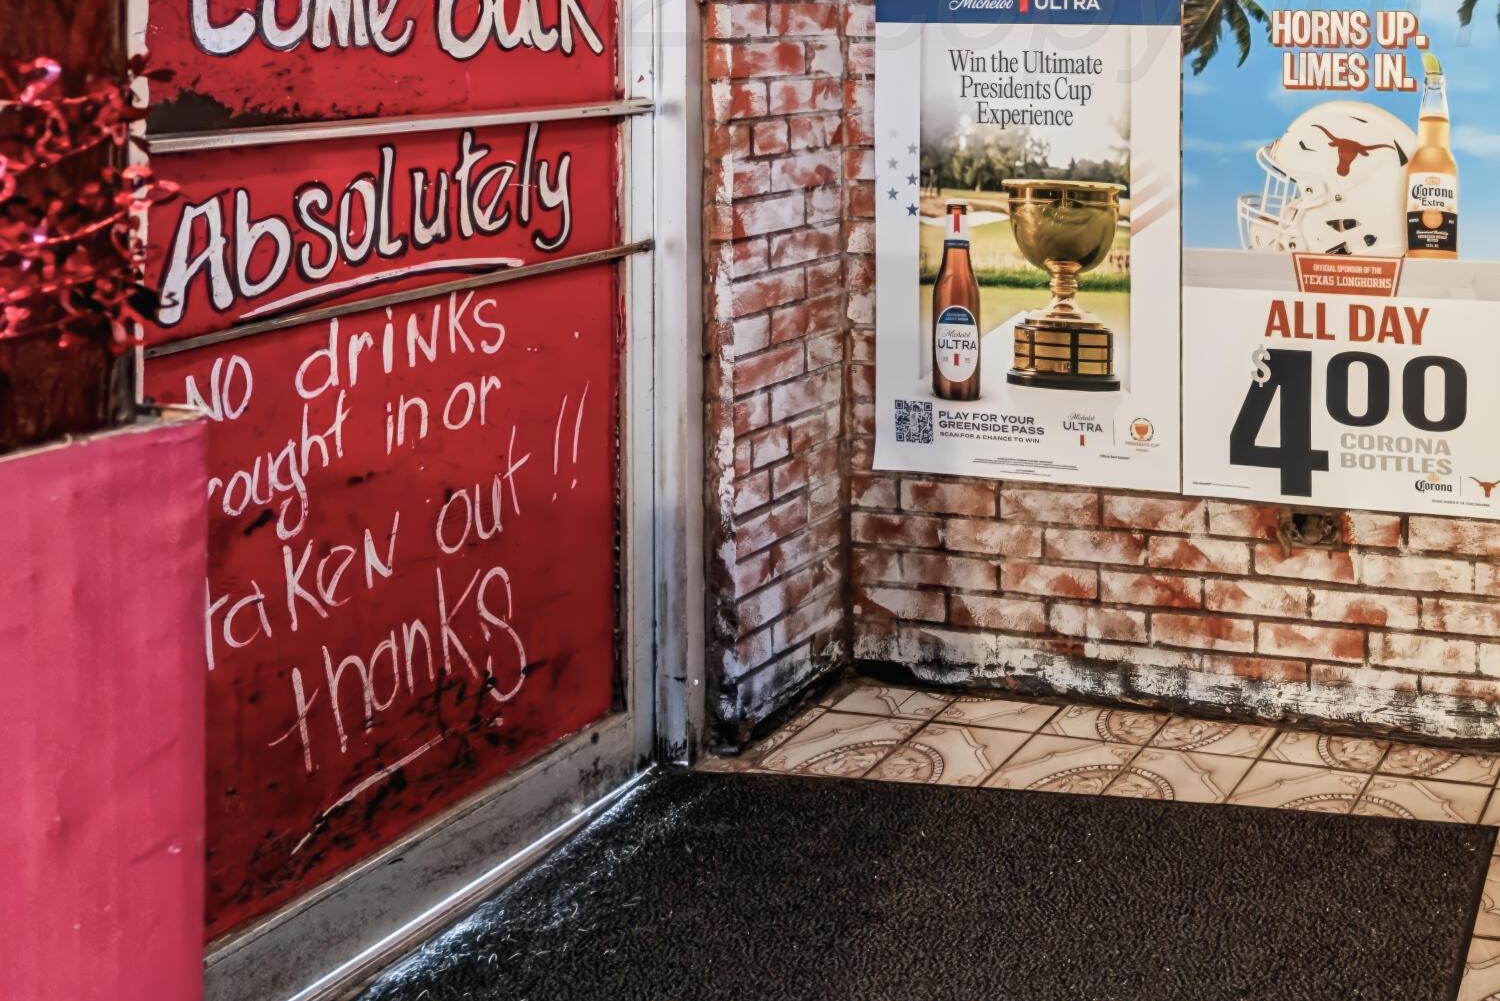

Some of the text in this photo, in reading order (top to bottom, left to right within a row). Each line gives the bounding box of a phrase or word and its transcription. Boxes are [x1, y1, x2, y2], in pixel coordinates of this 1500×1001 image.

[1271, 10, 1429, 50] HORNS UP.
[947, 49, 1103, 76] Win the Ultimate
[1282, 52, 1418, 92] LIMES IN.
[960, 75, 1093, 106] Presidents Cup
[975, 101, 1075, 130] Experience
[1411, 184, 1454, 200] Corona
[1421, 197, 1446, 207] Extra
[1303, 274, 1392, 289] TEXAS LONGHORNS
[1263, 299, 1431, 346] ALL DAY
[937, 338, 977, 351] ULTRA
[185, 354, 253, 422] NO
[938, 410, 1035, 425] PLAY FOR YOUR
[1062, 420, 1104, 433] ULTRA
[1011, 425, 1045, 436] PASS
[1339, 432, 1453, 456] CORONA
[206, 374, 501, 541] rought in or
[1339, 452, 1454, 476] BOTTLES
[435, 424, 533, 554] out
[1414, 479, 1453, 493] Corona
